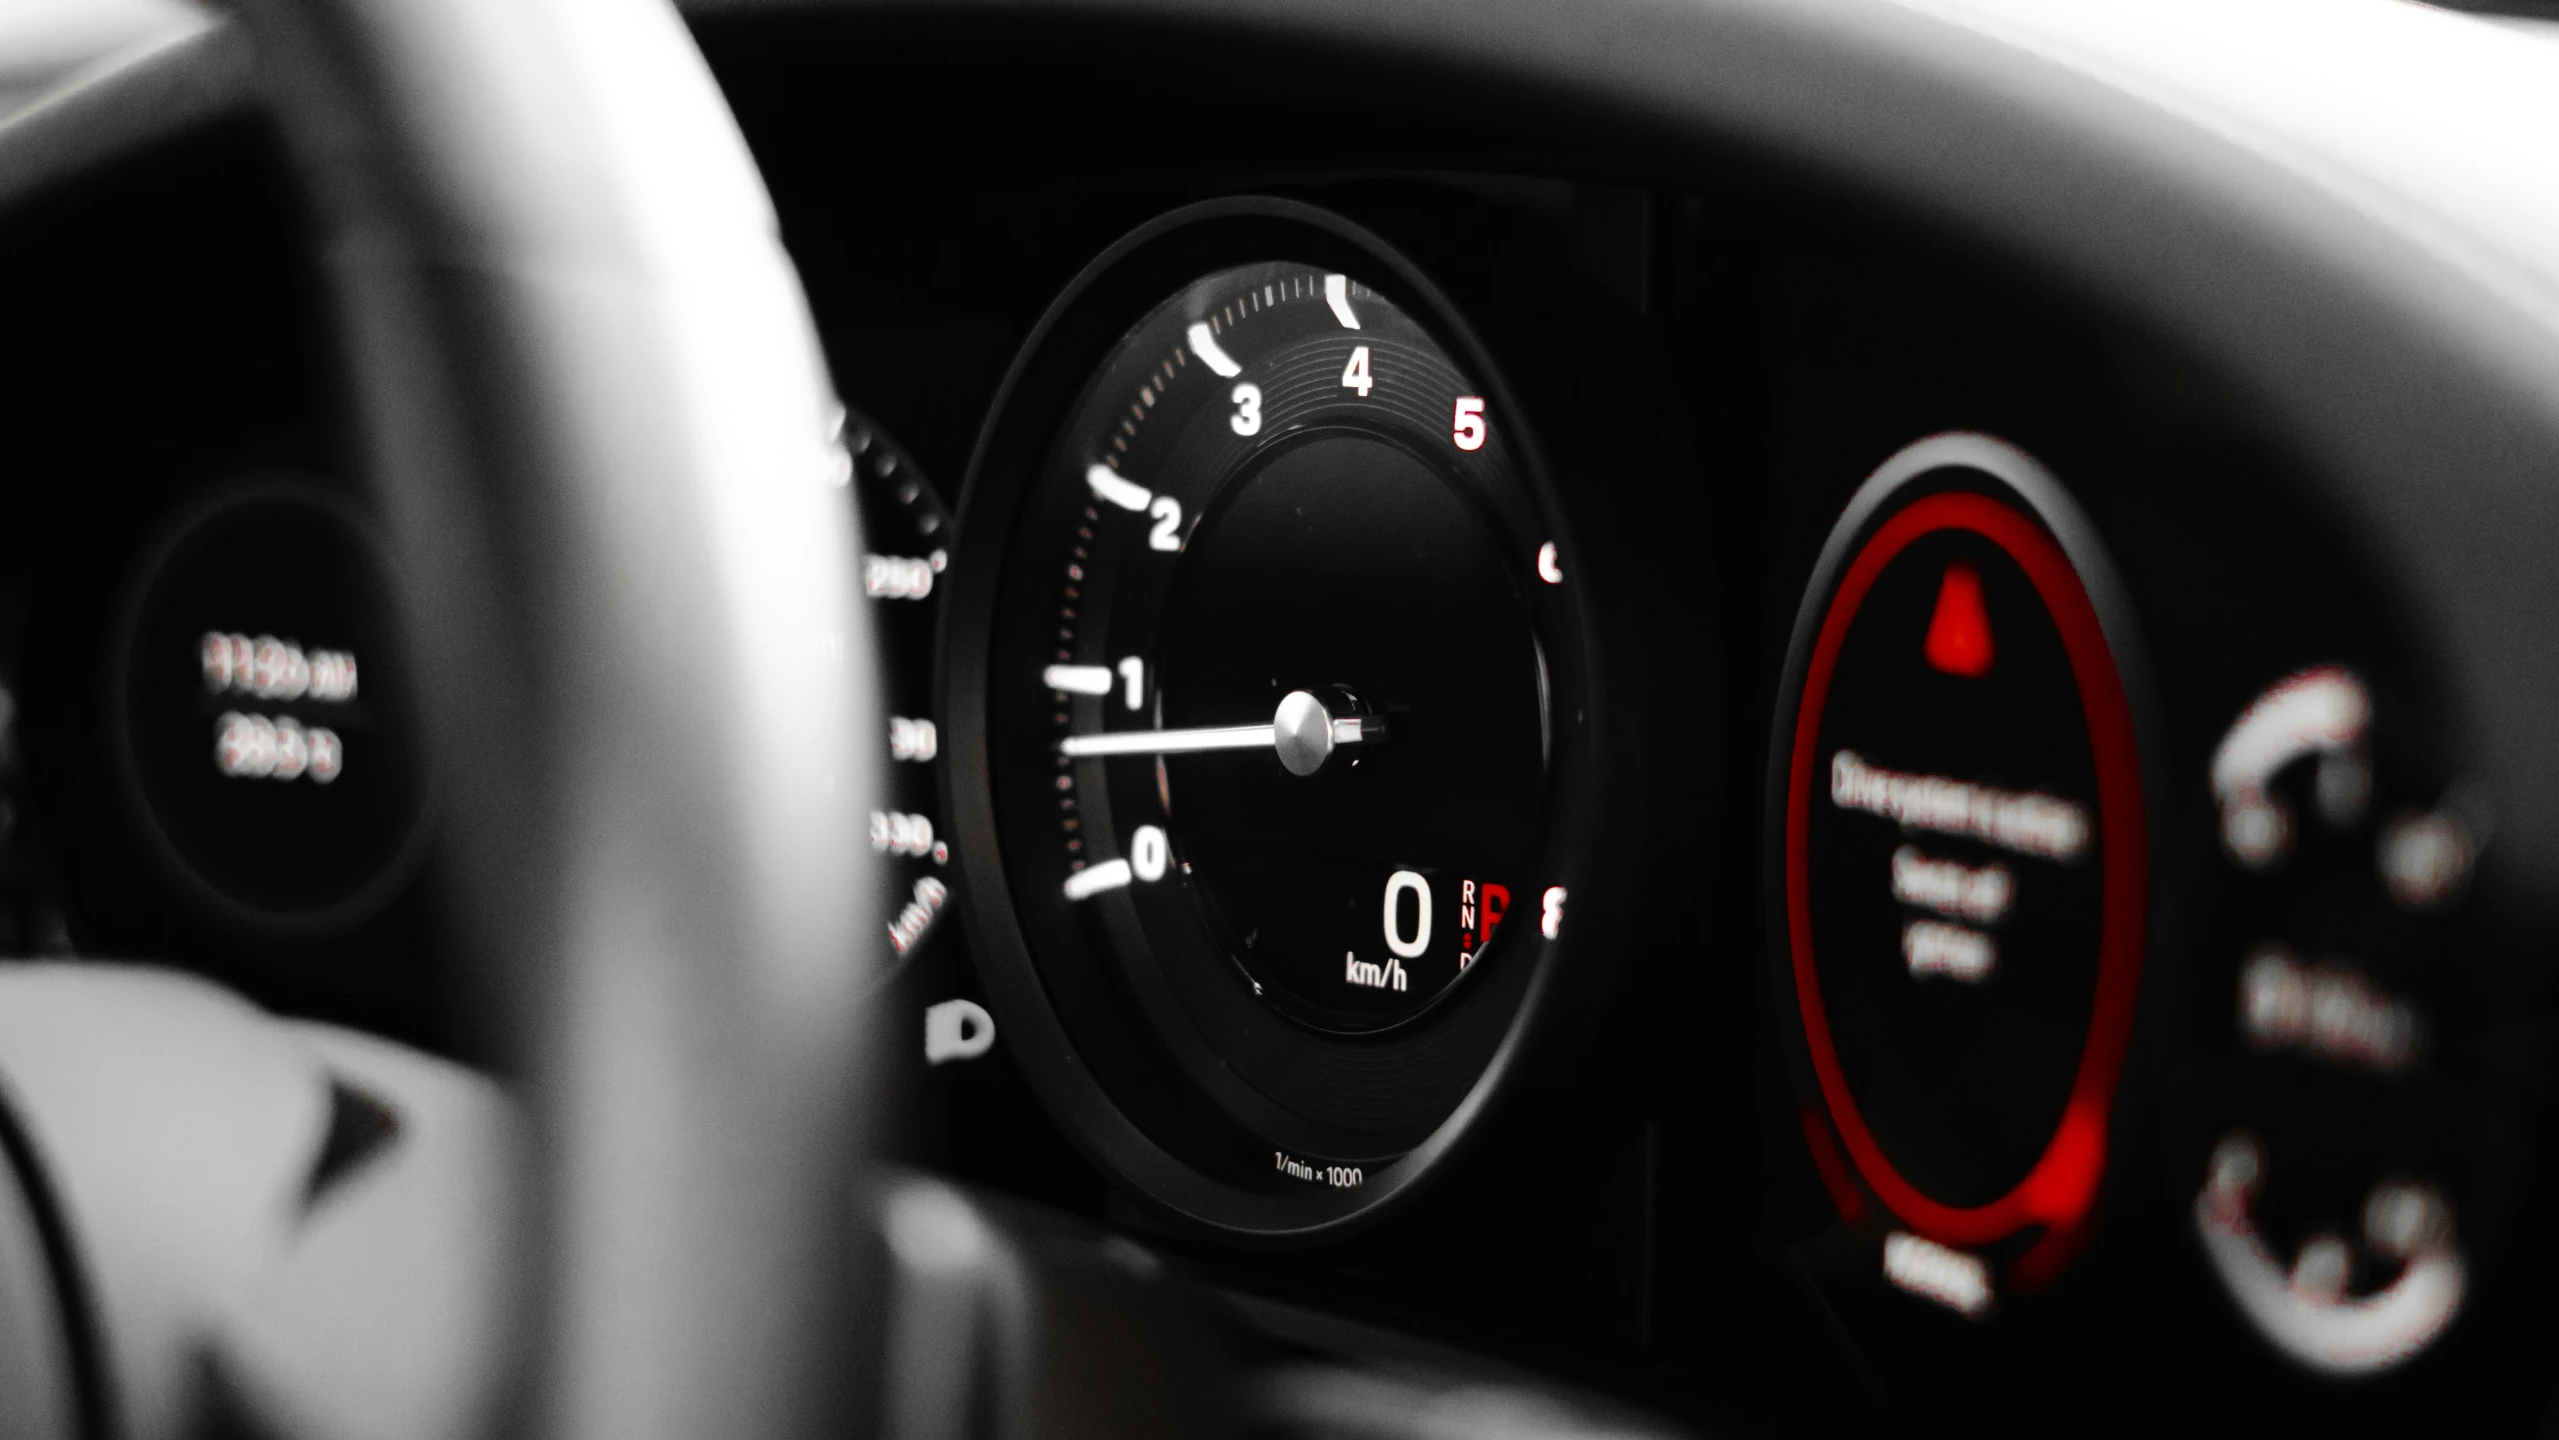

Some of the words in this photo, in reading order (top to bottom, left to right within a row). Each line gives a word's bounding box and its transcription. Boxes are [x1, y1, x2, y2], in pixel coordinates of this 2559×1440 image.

[1342, 346, 1374, 397] 4
[1230, 382, 1263, 437] 3
[1453, 396, 1488, 452] 5
[1149, 496, 1184, 553] 2
[1117, 655, 1144, 711] 1
[1130, 824, 1168, 883] 0
[1383, 869, 1433, 959] 0
[1461, 904, 1476, 931] N
[1462, 879, 1476, 905] R
[1480, 882, 1511, 944] P
[1346, 950, 1408, 992] km/h
[1275, 1151, 1313, 1181] 1/min
[1326, 1166, 1363, 1188] 1000
